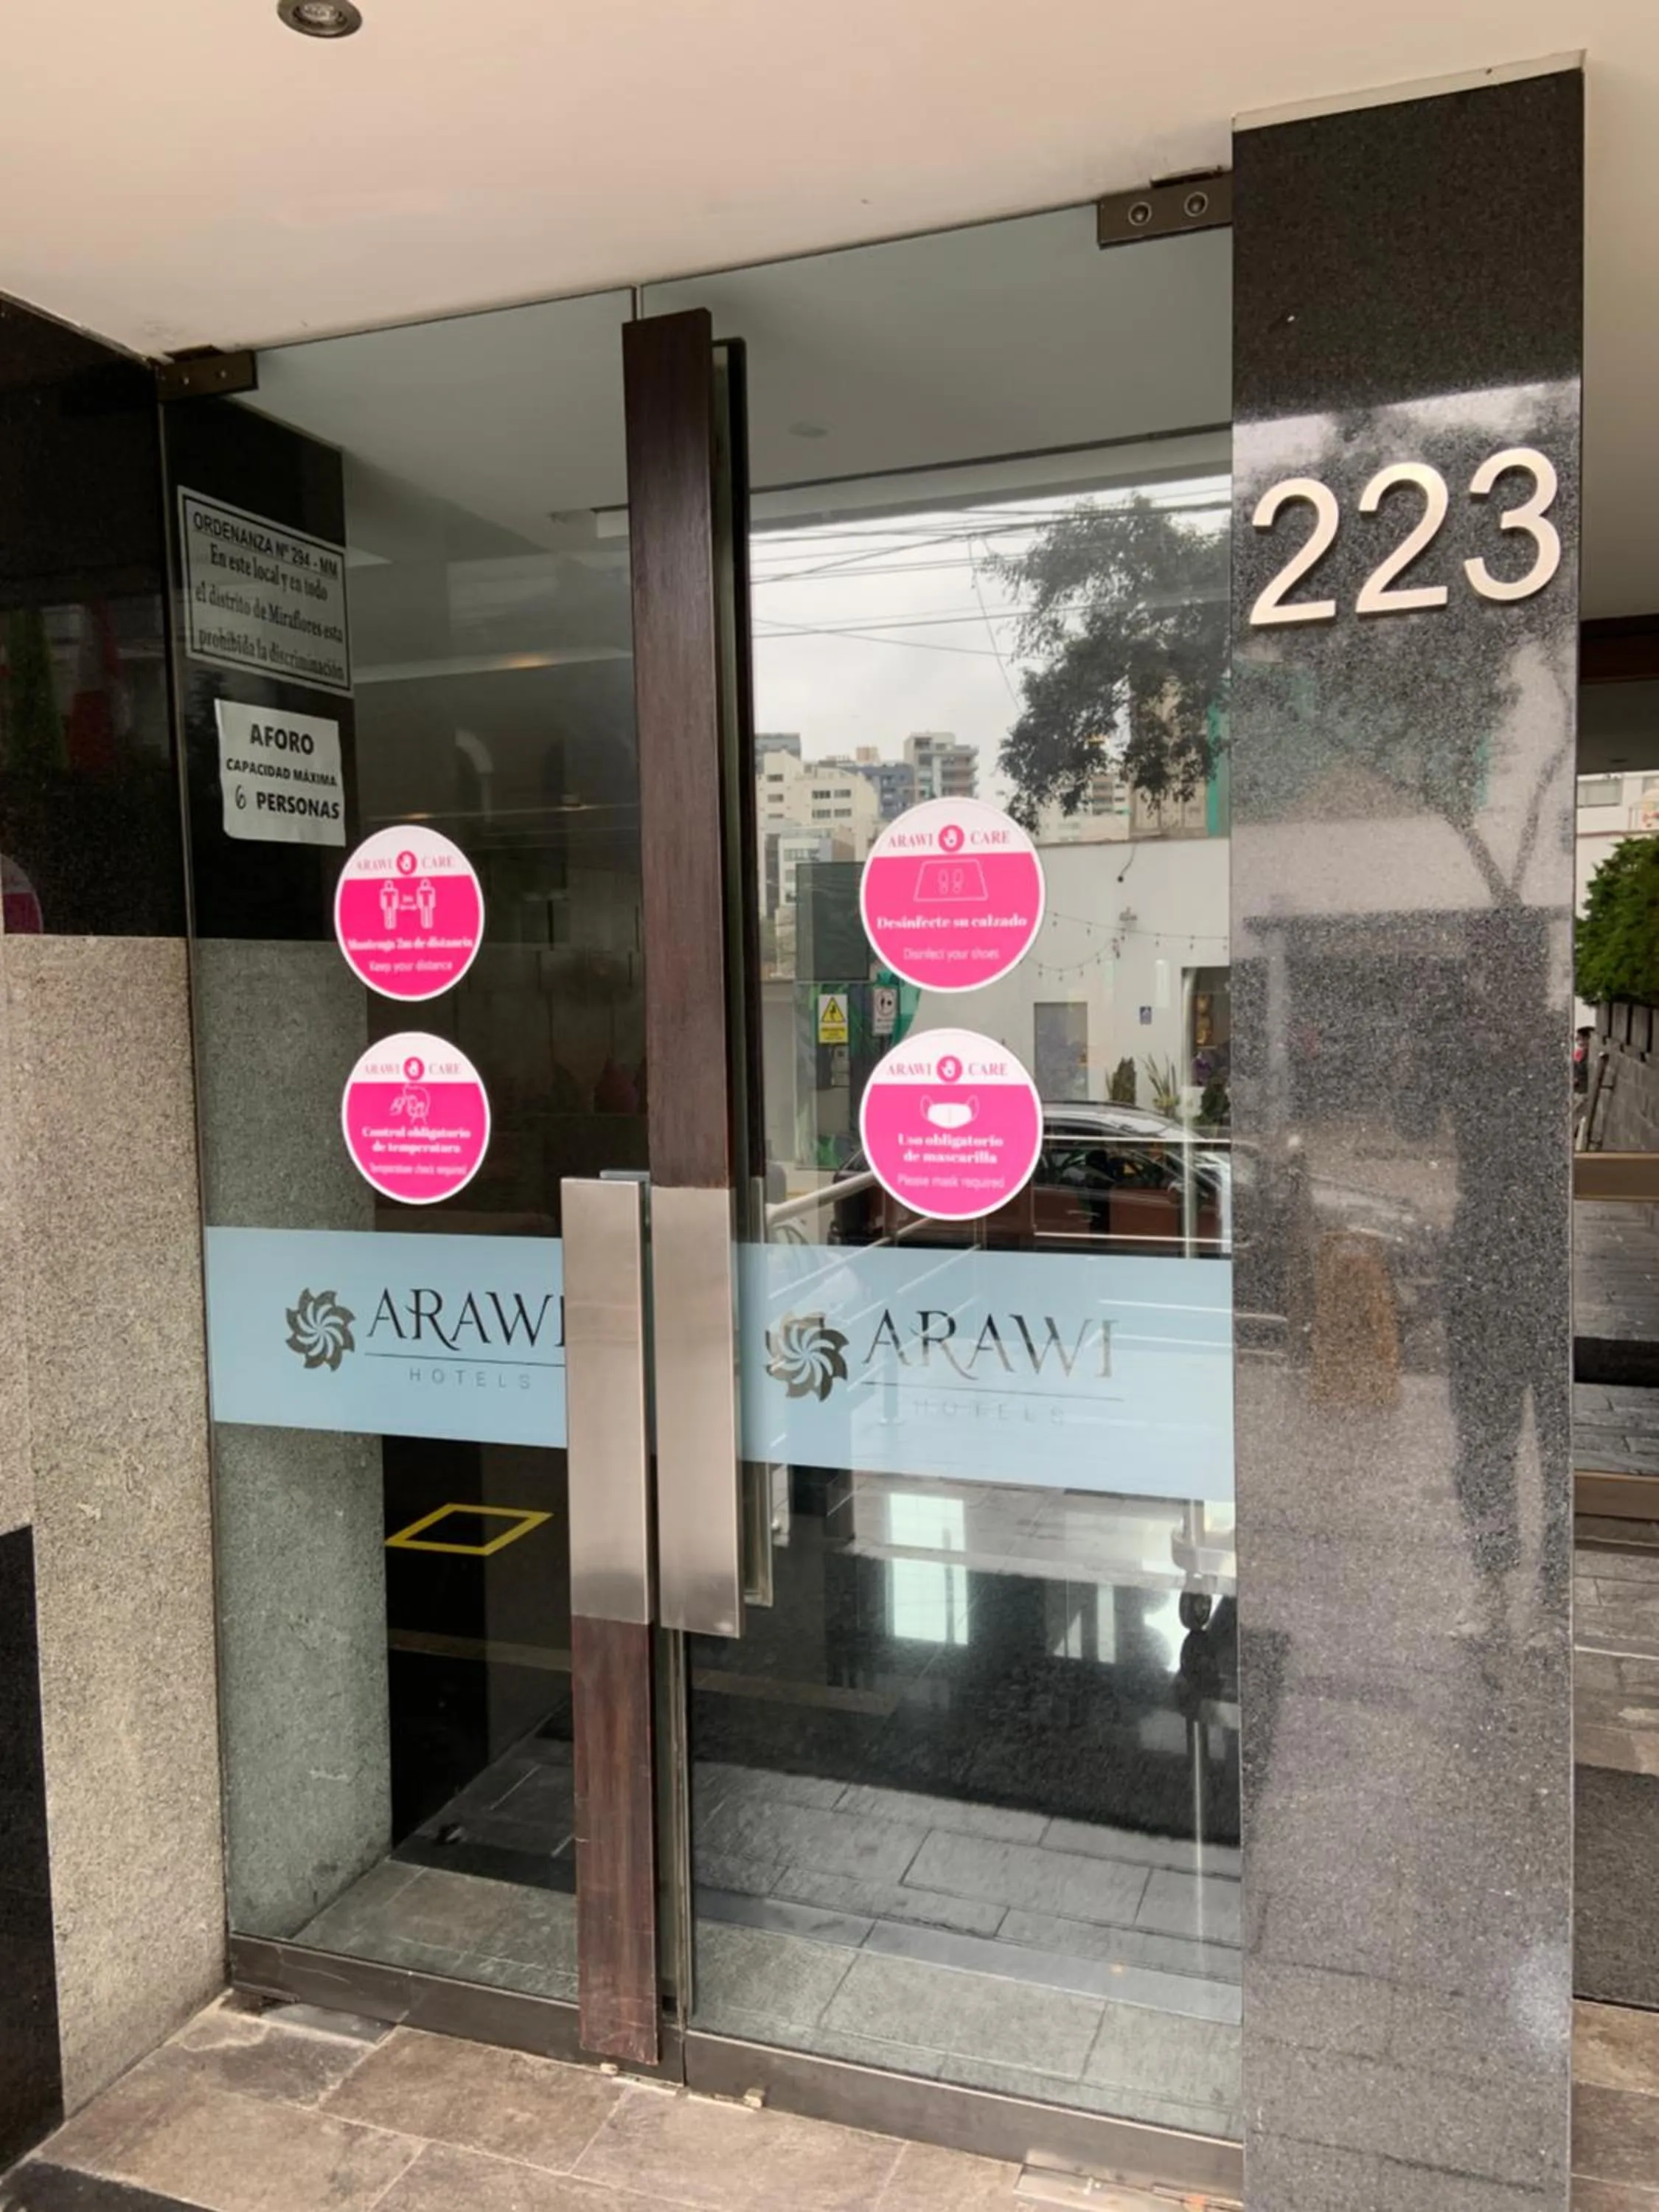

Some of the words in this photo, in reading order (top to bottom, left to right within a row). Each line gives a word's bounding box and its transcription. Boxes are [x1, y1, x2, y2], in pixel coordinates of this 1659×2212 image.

[193, 512, 273, 554] ORDENANZA
[1251, 448, 1561, 625] 223
[211, 543, 226, 568] En
[229, 556, 251, 577] este
[253, 557, 279, 585] local
[305, 578, 328, 602] todo
[195, 580, 206, 603] el
[209, 584, 251, 616] distrito
[254, 597, 266, 620] de
[268, 603, 322, 637] Miraflores
[198, 627, 256, 658] prohibida
[257, 637, 268, 661] la
[250, 723, 314, 756] AFORO
[226, 758, 291, 780] CAPACIDAD
[293, 768, 337, 787] MÁXIMA
[234, 784, 246, 810] 6
[256, 791, 340, 819] PERSONAS
[888, 833, 933, 849] ARAWI
[970, 830, 1010, 846] CARE
[422, 855, 456, 869] CARE
[876, 914, 950, 930] Desinfecte
[953, 919, 969, 928] su
[971, 912, 1028, 928] calzado
[428, 1062, 462, 1075] CARE
[887, 1062, 932, 1076] ARAWI
[968, 1062, 1009, 1076] CARE
[361, 1126, 406, 1138] Control
[925, 1133, 1004, 1149] obligatorio
[903, 1150, 921, 1163] de
[922, 1150, 998, 1164] mascarilla
[931, 1175, 959, 1188] mask
[960, 1175, 1005, 1192] required
[366, 1287, 566, 1351] ARAWI
[863, 1309, 1119, 1380] ARAWI
[409, 1368, 531, 1390] HOTELS
